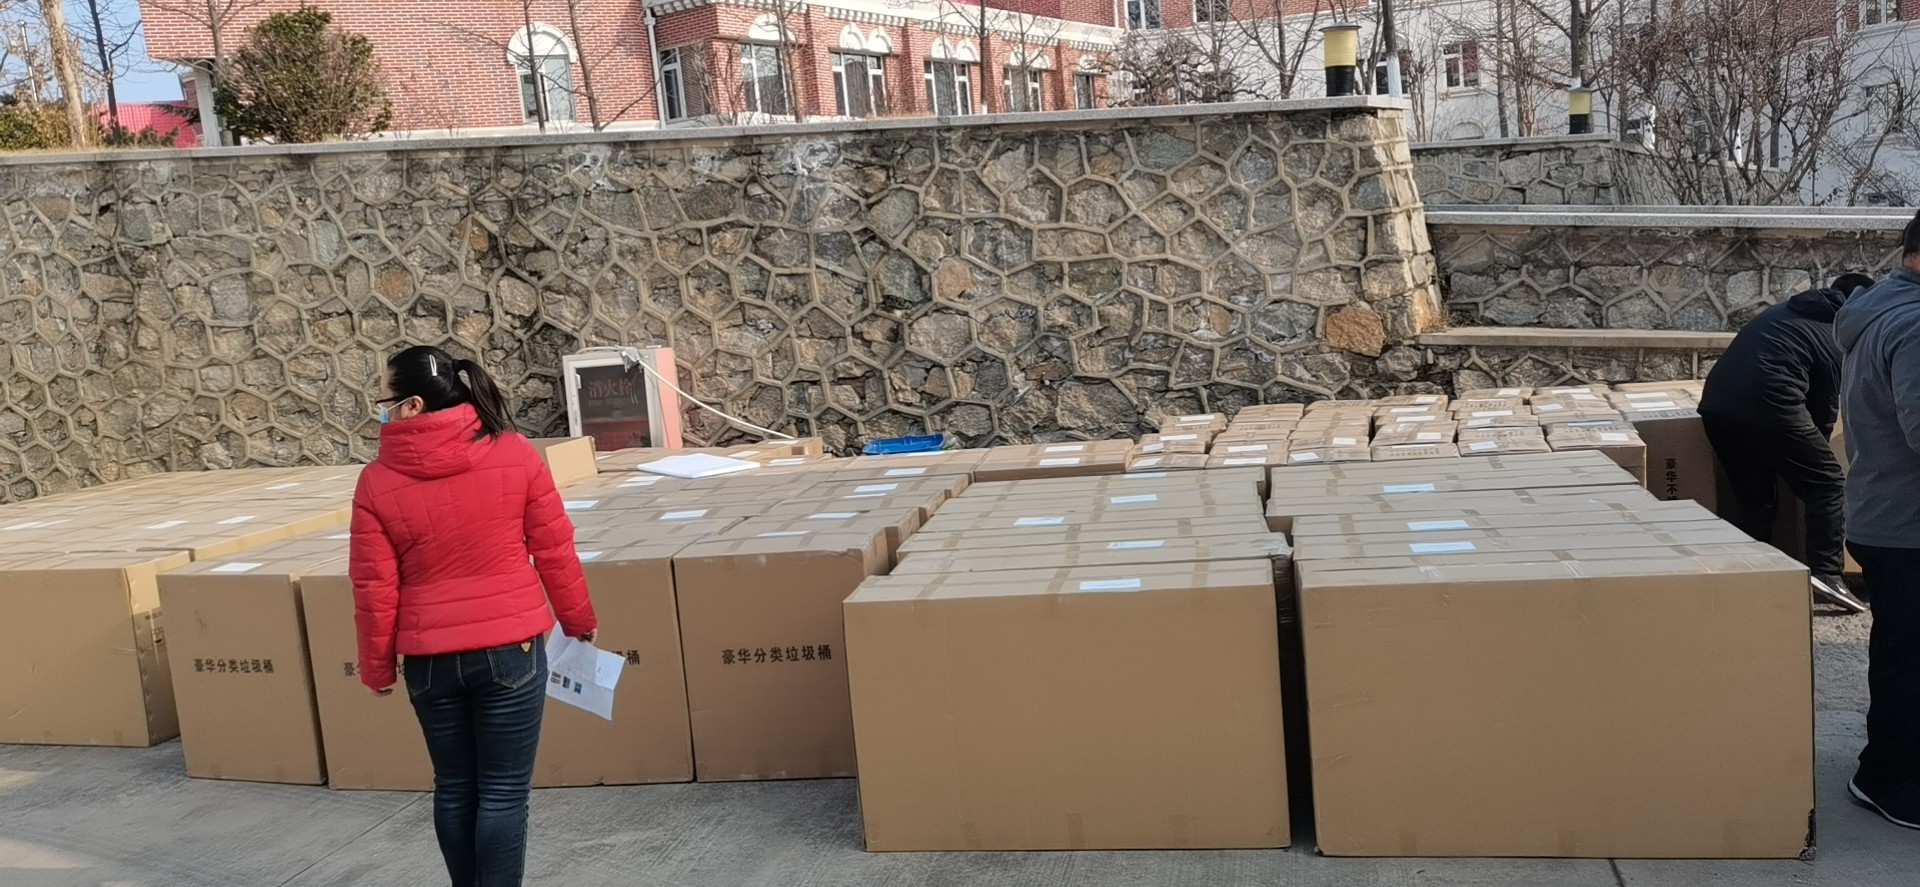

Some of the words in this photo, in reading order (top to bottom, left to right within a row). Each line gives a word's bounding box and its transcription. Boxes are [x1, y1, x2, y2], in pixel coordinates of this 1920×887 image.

[721, 644, 832, 665] 豪华分类垃圾桶
[194, 658, 274, 673] 豪华分类垃圾桶
